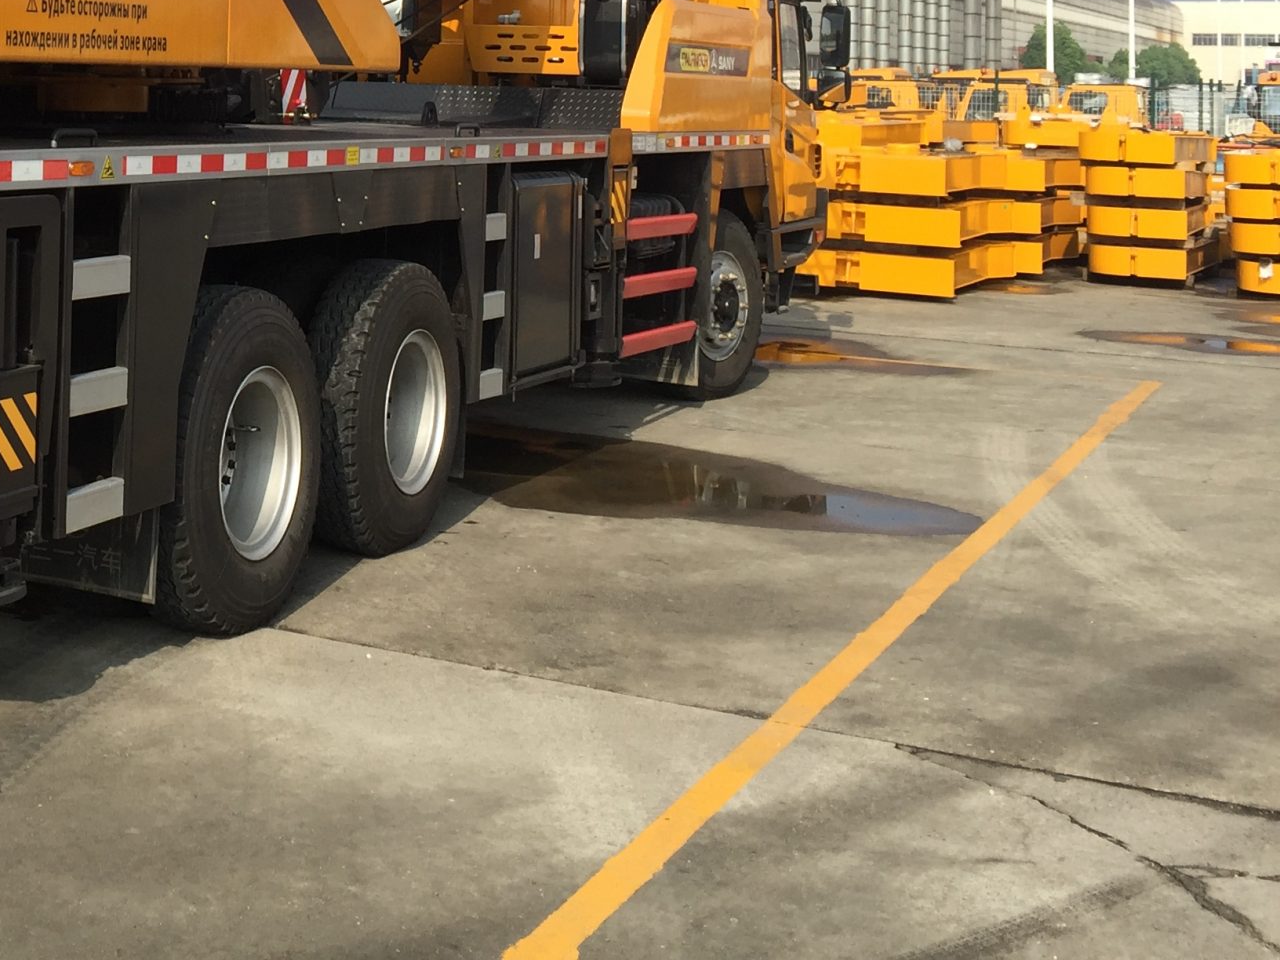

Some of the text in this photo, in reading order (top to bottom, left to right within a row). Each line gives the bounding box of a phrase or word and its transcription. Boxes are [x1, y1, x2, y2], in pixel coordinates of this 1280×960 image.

[77, 0, 129, 22] осторожны
[131, 3, 148, 24] при
[5, 28, 168, 56] нахождении в рабочей зоне крана
[718, 55, 736, 71] SANY
